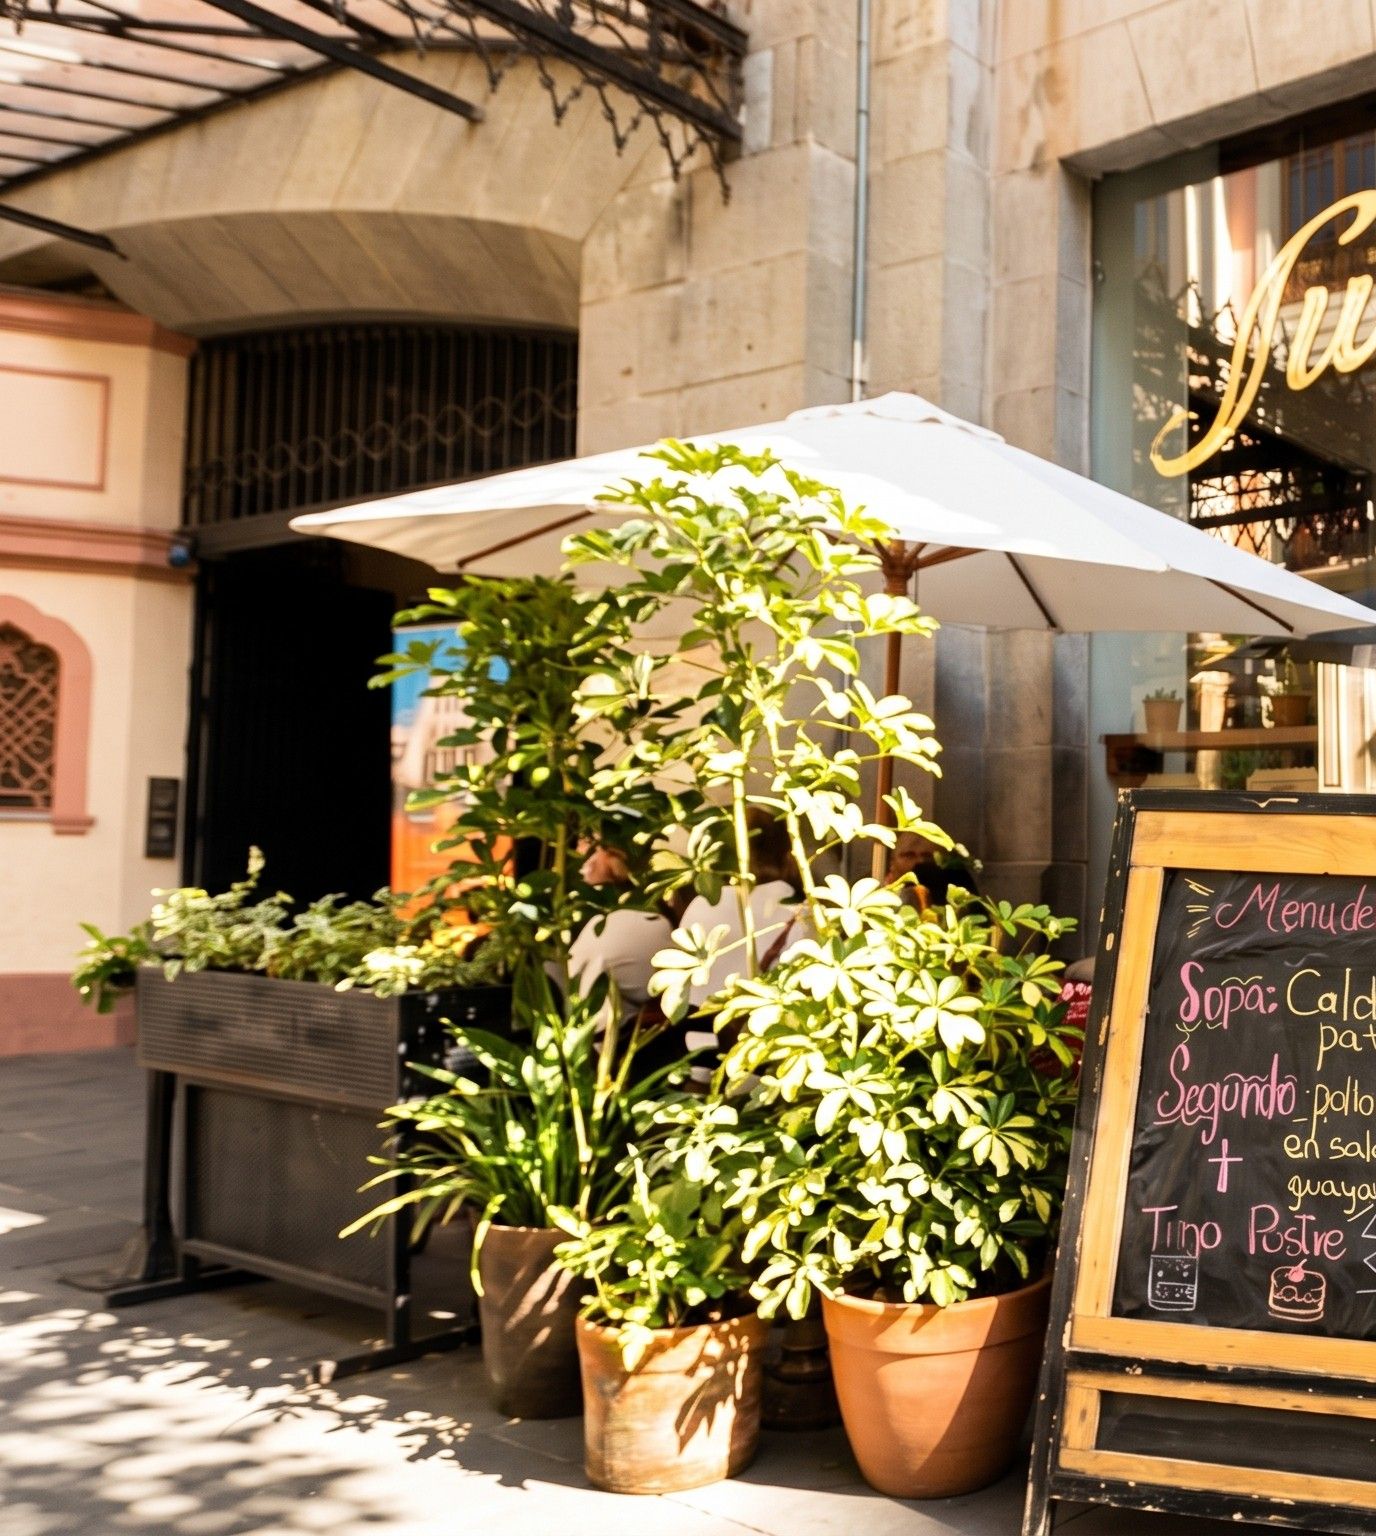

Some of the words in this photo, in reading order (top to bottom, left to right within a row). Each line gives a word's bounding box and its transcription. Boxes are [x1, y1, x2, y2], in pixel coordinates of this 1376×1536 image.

[1215, 883, 1337, 935] Menu
[1180, 961, 1278, 1029] Sopa:
[1283, 1134, 1320, 1159] en
